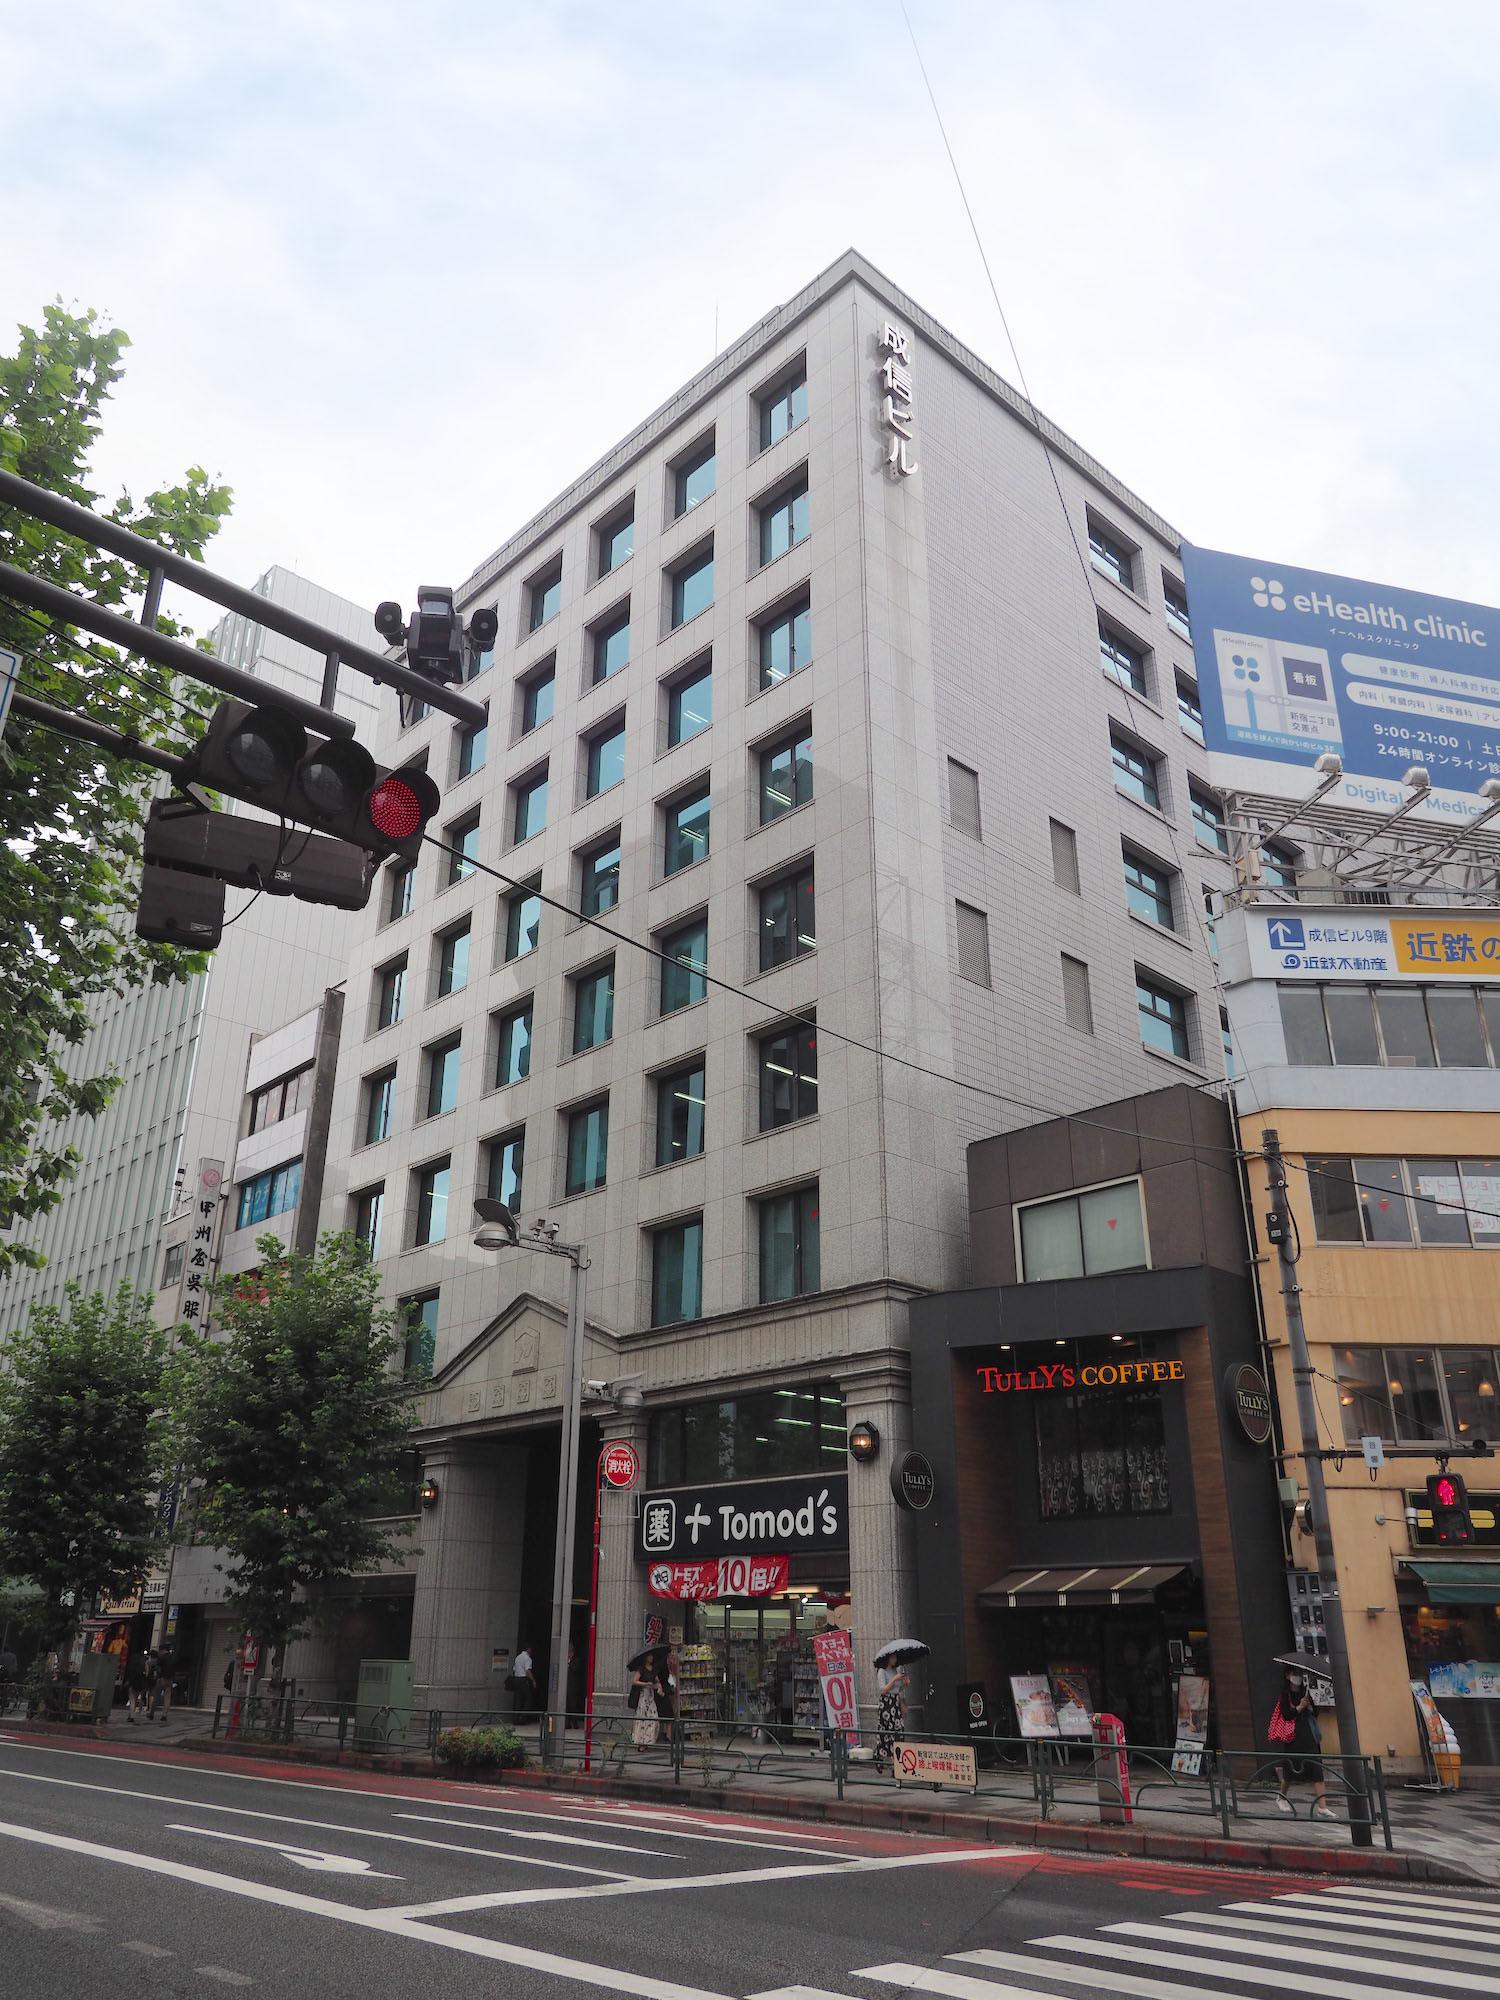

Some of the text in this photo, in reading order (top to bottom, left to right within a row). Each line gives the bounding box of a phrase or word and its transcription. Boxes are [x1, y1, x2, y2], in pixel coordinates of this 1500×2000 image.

[880, 320, 918, 475] 成信ビル
[1293, 591, 1488, 647] eHealth clinic
[1329, 627, 1419, 650] イーヘルスクリニック
[1293, 672, 1317, 686] 看板
[1290, 711, 1335, 727] 新宿二丁目
[1373, 723, 1459, 748] 9:00-21:00
[1344, 783, 1404, 806] Digital
[1308, 928, 1388, 944] 成信ビル9階
[1303, 956, 1388, 971] 近鉄不動産
[977, 1360, 1186, 1393] TULLY'S COFFEE
[608, 1458, 632, 1475] 消火栓
[649, 1507, 670, 1543] 薬
[718, 1489, 838, 1541] Tomod's
[674, 1566, 704, 1582] トモズ
[718, 1559, 746, 1592] 10
